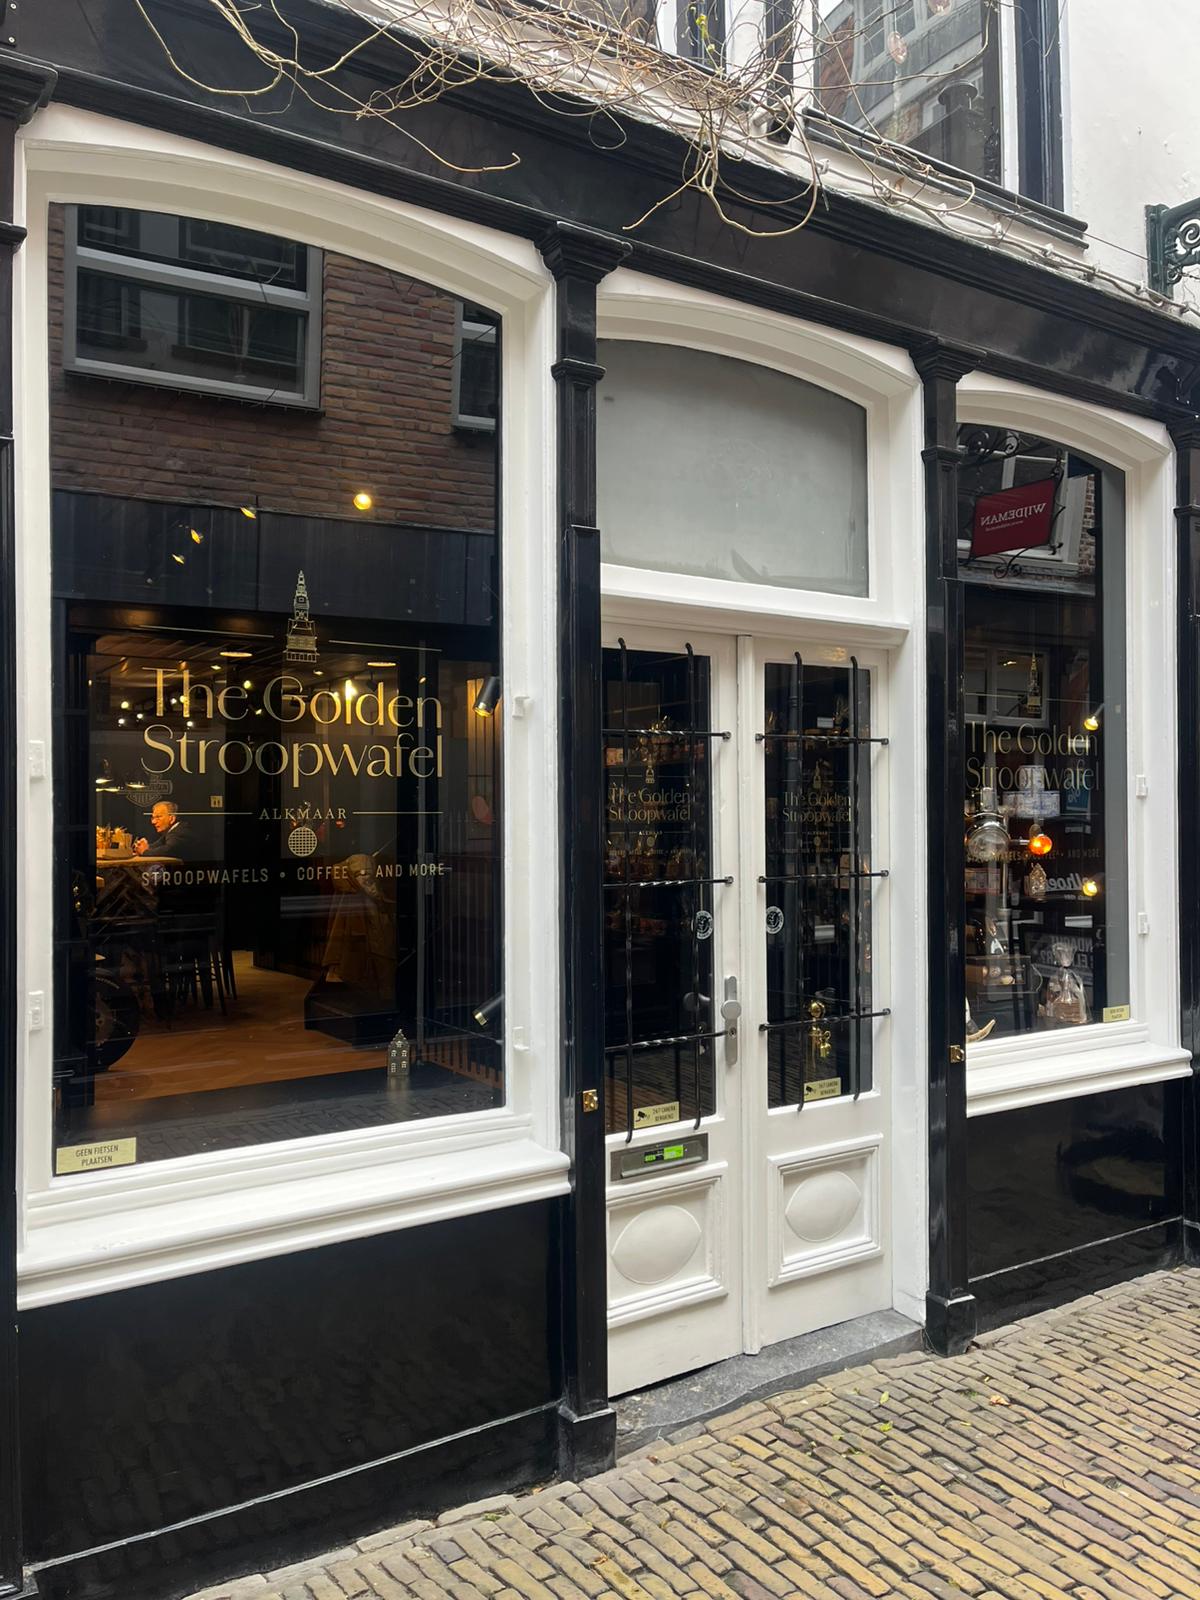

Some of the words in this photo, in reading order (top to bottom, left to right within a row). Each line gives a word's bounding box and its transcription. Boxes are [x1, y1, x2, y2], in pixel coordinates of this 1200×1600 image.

[142, 667, 249, 720] The
[263, 676, 442, 728] Golden
[967, 720, 1011, 754] The
[1017, 723, 1098, 757] Golden
[141, 724, 443, 788] Stroopwafel
[638, 786, 690, 804] Golden
[259, 807, 347, 820] ALKMAAR
[609, 805, 690, 824] Stoopwafel
[141, 868, 270, 887] STROOPWAFELS
[297, 865, 348, 881] COFFEE
[375, 863, 403, 879] AND
[409, 862, 445, 878] MORE
[75, 1148, 93, 1157] GEEN
[94, 1145, 119, 1155] FIETSEN
[81, 1155, 113, 1167] PLAATSEN
